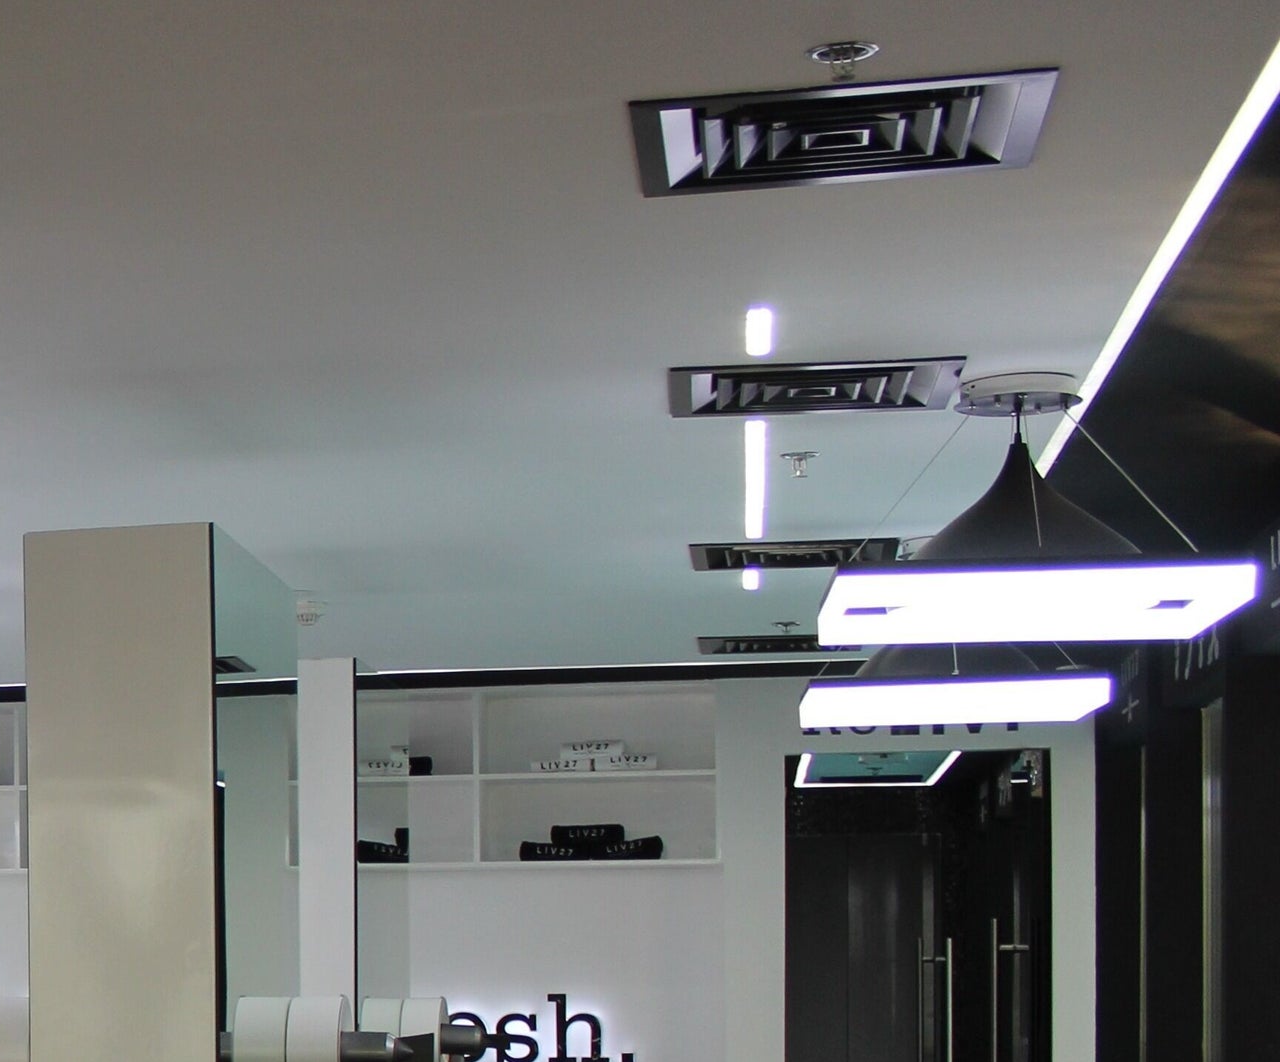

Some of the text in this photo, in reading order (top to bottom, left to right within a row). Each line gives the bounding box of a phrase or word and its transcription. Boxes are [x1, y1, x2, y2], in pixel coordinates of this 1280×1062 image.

[571, 743, 610, 751] LIV27
[609, 755, 648, 763] LIV27
[540, 760, 578, 770] LIV27
